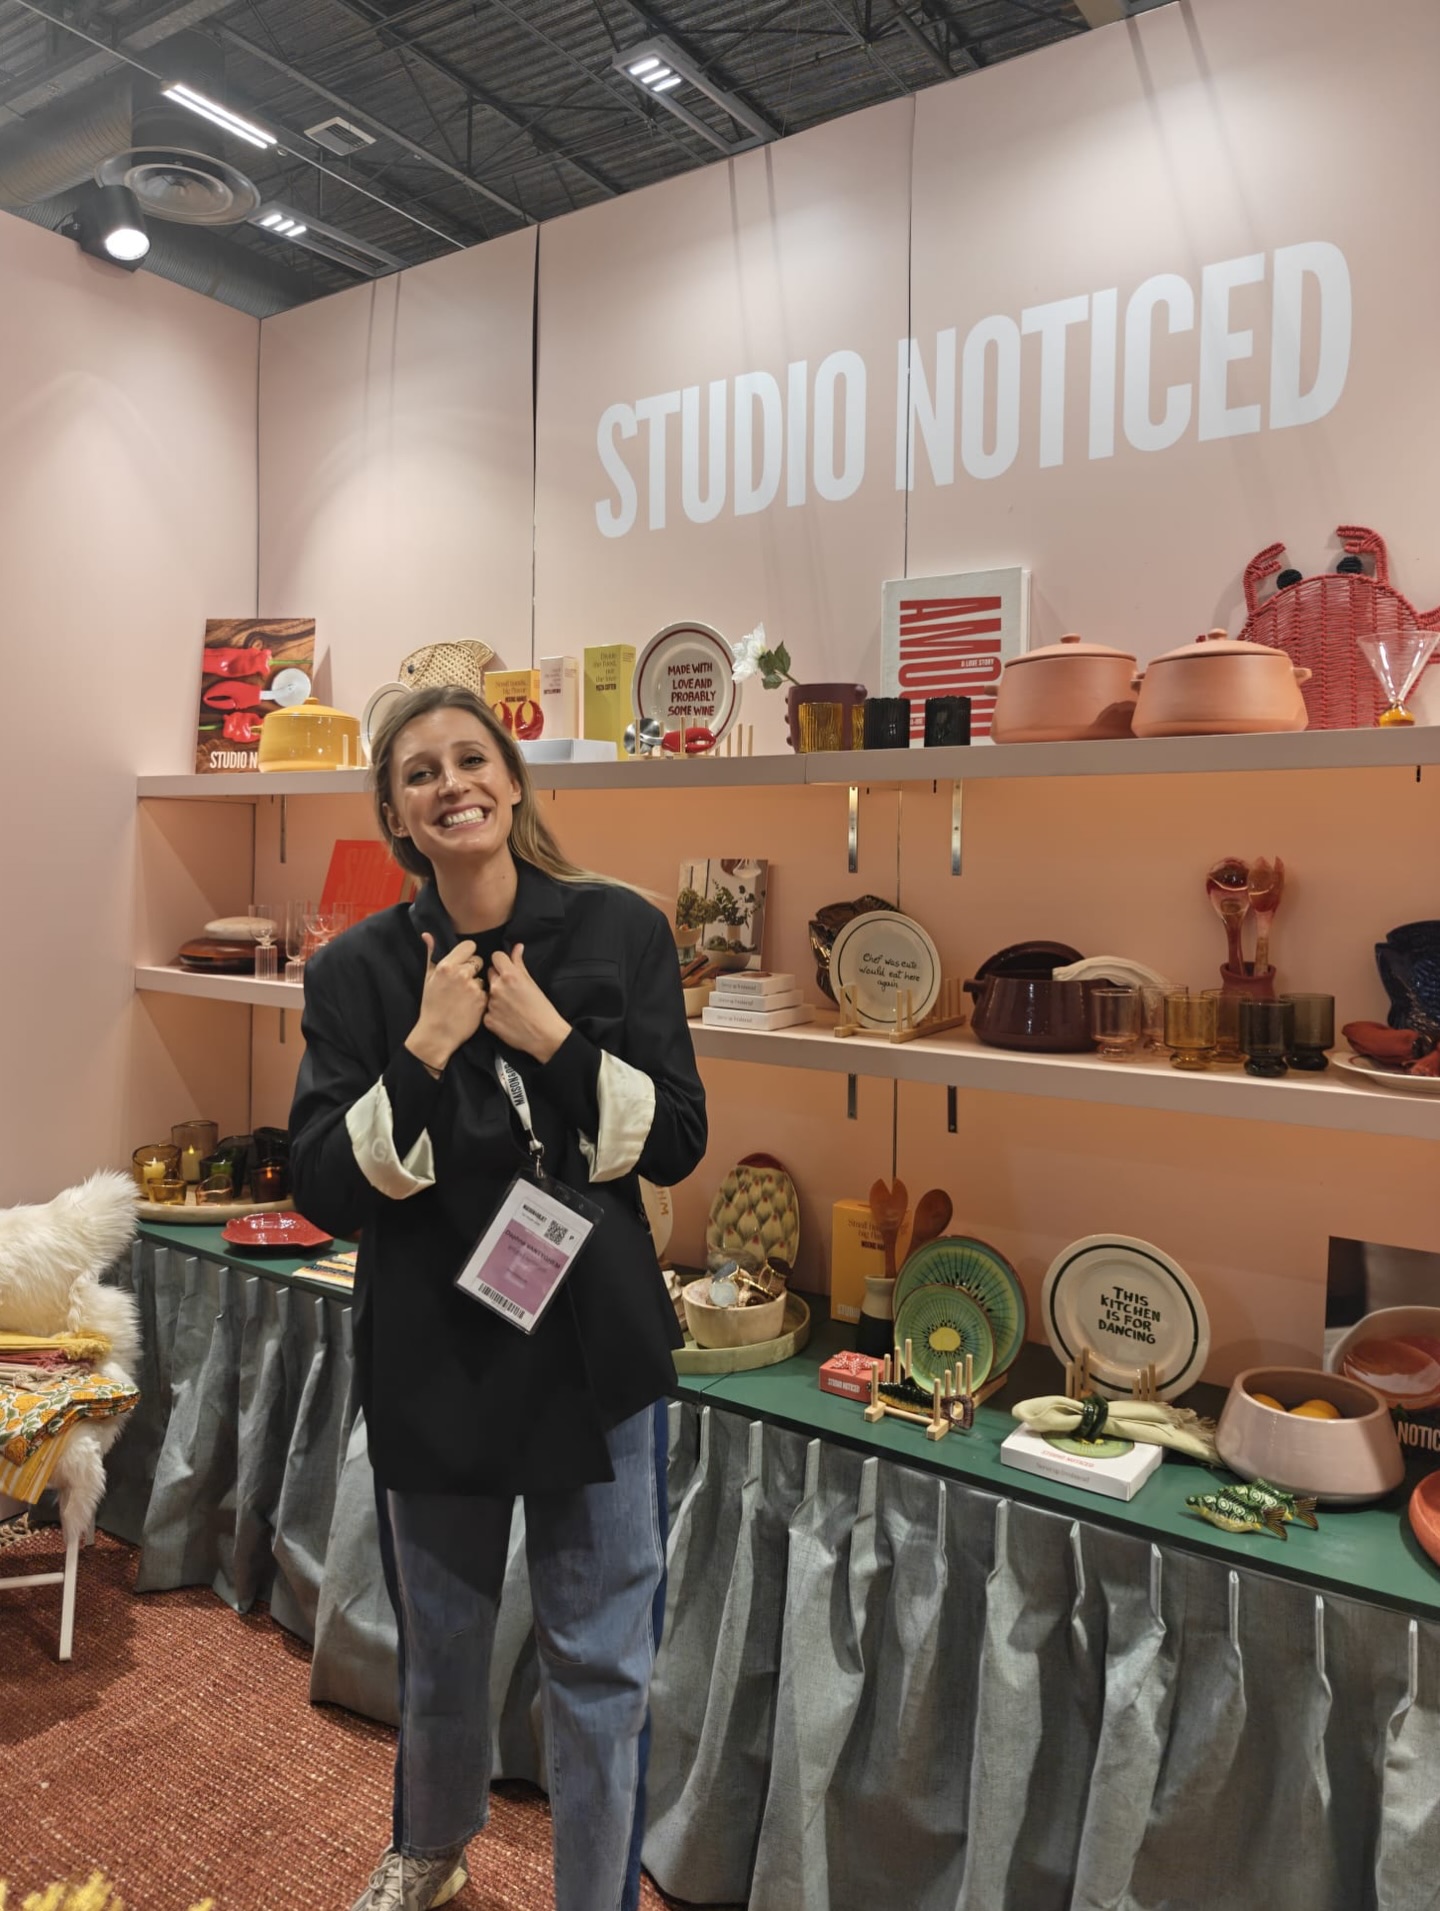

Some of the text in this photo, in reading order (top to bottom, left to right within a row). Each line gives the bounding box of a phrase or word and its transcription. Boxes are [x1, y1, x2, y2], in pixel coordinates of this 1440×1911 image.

[594, 241, 1353, 539] STUDIO NOTICED
[667, 662, 713, 676] MADE WITH
[979, 658, 995, 666] STORY
[672, 678, 713, 690] LOVE AND
[671, 690, 716, 703] PROBABLY
[667, 705, 715, 717] SOME WINE
[209, 751, 248, 769] STUDIO
[863, 953, 884, 965] Chef
[885, 959, 900, 968] was
[859, 966, 920, 982] would eat here
[877, 980, 898, 992] again
[1112, 1286, 1149, 1306] THIS
[1100, 1294, 1161, 1322] KITCHEN
[1106, 1309, 1152, 1332] IS FOR
[1098, 1319, 1156, 1345] DANCING
